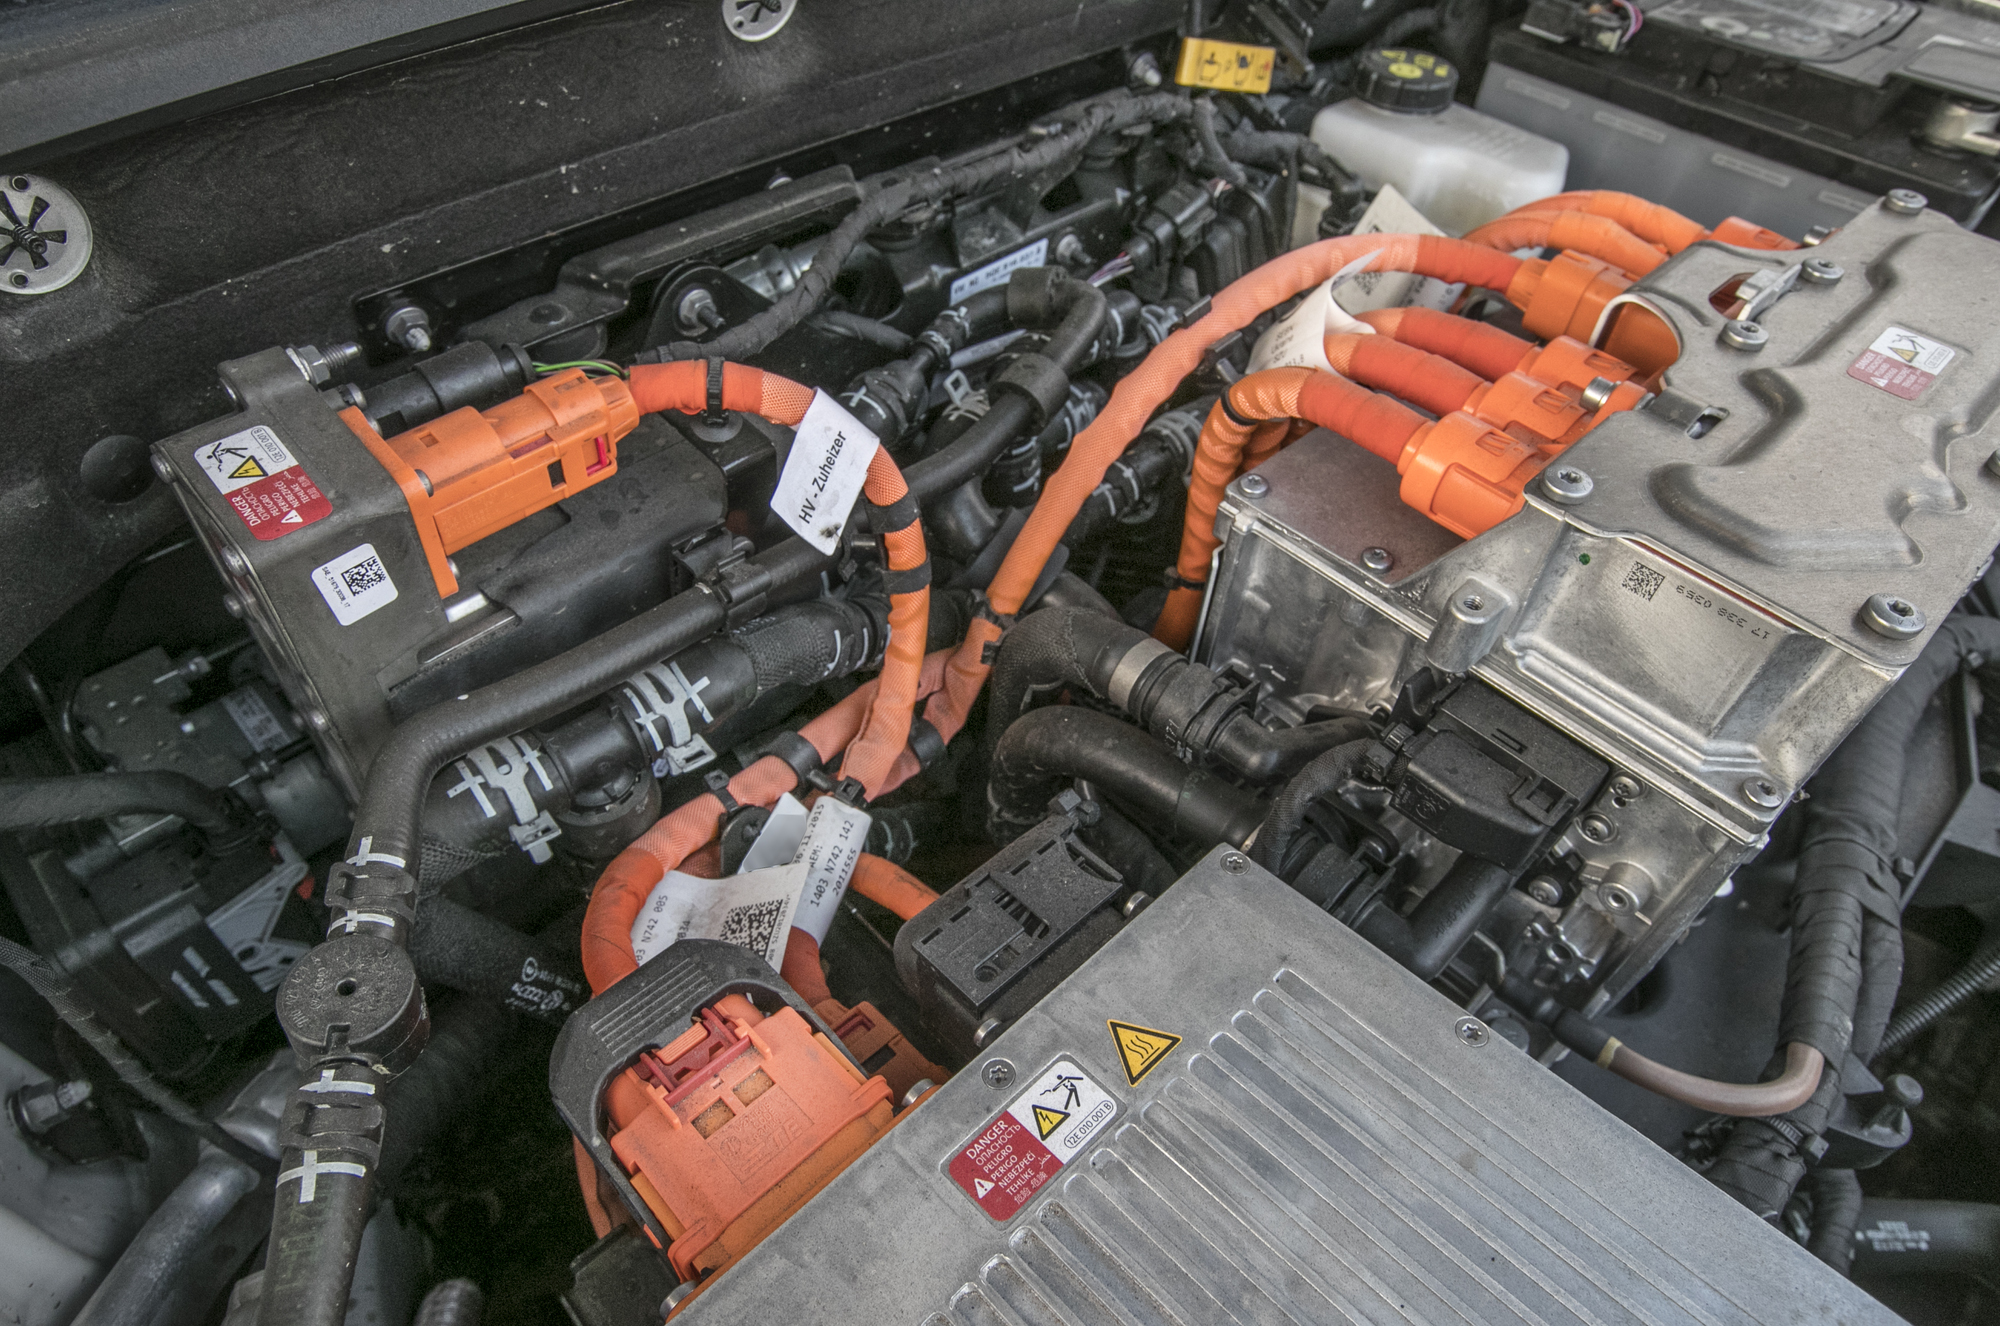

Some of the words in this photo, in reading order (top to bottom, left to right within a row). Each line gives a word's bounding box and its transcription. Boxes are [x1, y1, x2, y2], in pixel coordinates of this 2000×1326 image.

[798, 497, 815, 524] HV
[811, 430, 845, 492] Zuheizer
[231, 495, 261, 526] DANGER
[241, 486, 270, 520] ОПАСНОСТЬ
[259, 493, 280, 516] PELIGRO
[271, 491, 291, 512] PERIGO
[1674, 583, 1712, 609] 0359
[1716, 606, 1747, 628] 338
[1750, 627, 1770, 640] 17
[810, 877, 829, 906] 1403
[824, 844, 843, 874] N742
[838, 819, 854, 840] 142
[833, 847, 857, 896] 2011555
[640, 917, 658, 943] N742
[652, 894, 668, 912] 005
[965, 1119, 1008, 1159] DANGER
[1066, 1131, 1081, 1145] 12E
[1078, 1119, 1093, 1135] 010
[1090, 1107, 1106, 1122] 001
[1103, 1102, 1111, 1110] B
[975, 1122, 1021, 1166] ОПАСНОСТЬ
[982, 1143, 1013, 1173] PELIGRO
[990, 1153, 1018, 1181] PERIGO
